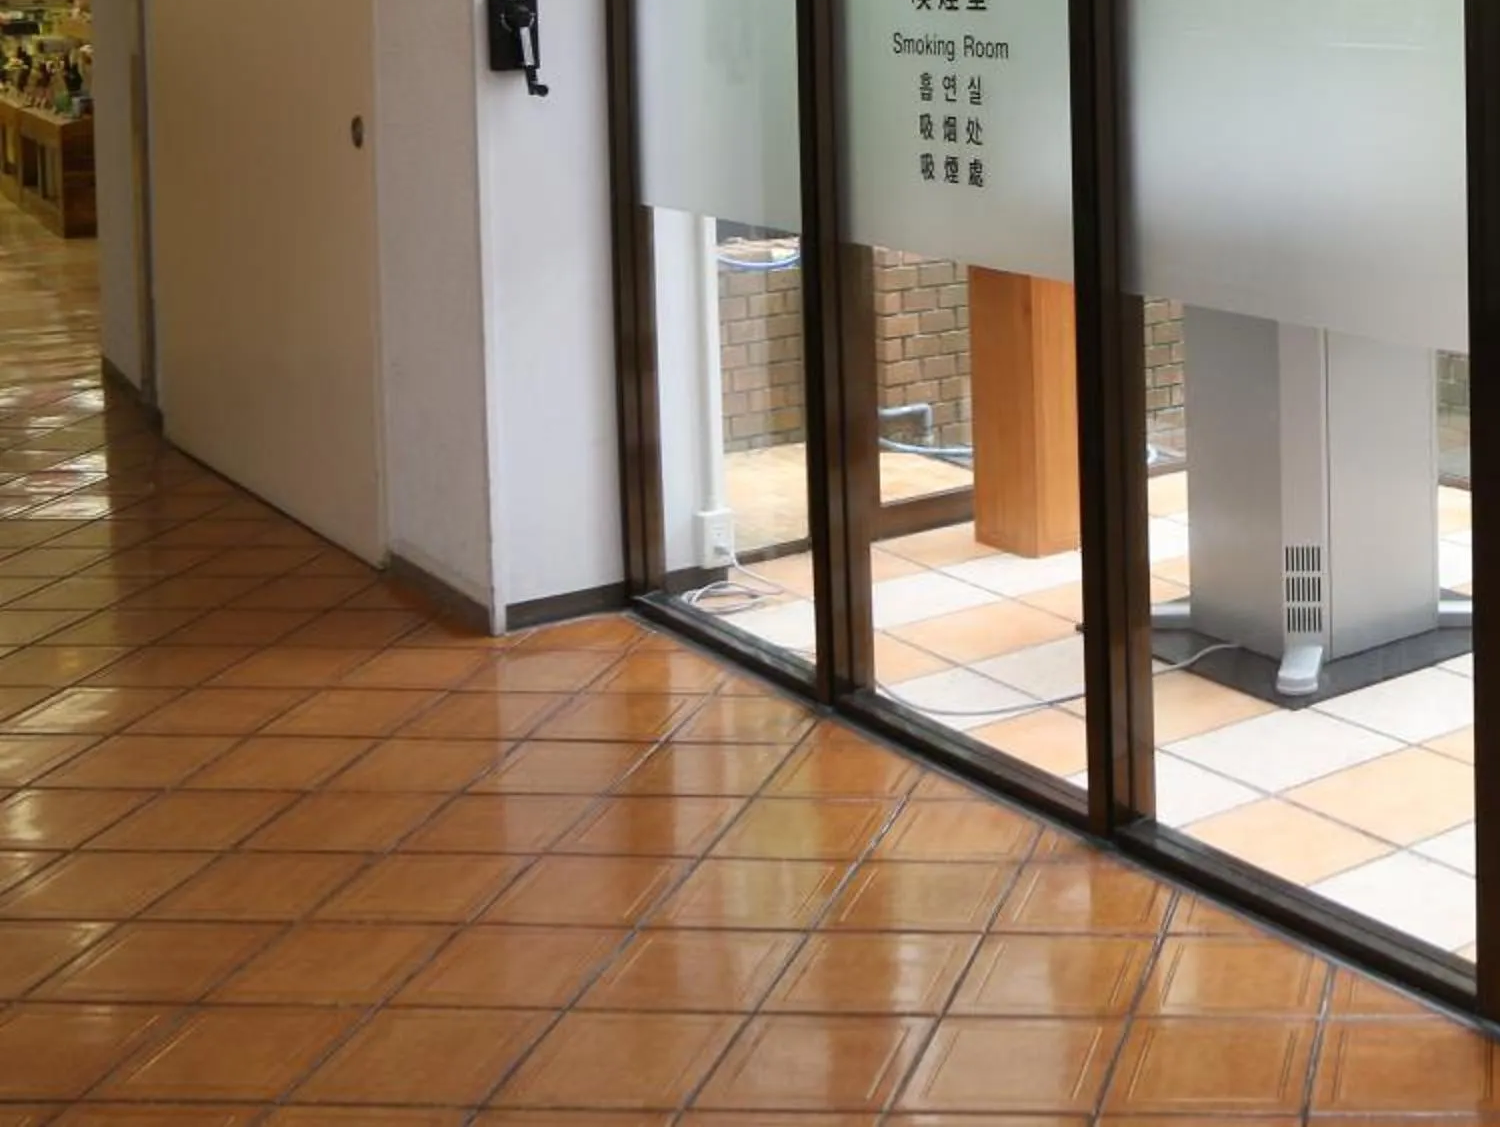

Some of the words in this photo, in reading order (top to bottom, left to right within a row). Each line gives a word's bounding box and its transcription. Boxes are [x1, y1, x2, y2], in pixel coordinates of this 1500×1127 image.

[893, 32, 955, 62] Smoking
[963, 35, 1009, 59] Room
[919, 72, 983, 106] 흡연실
[919, 113, 984, 146] 吸烟处
